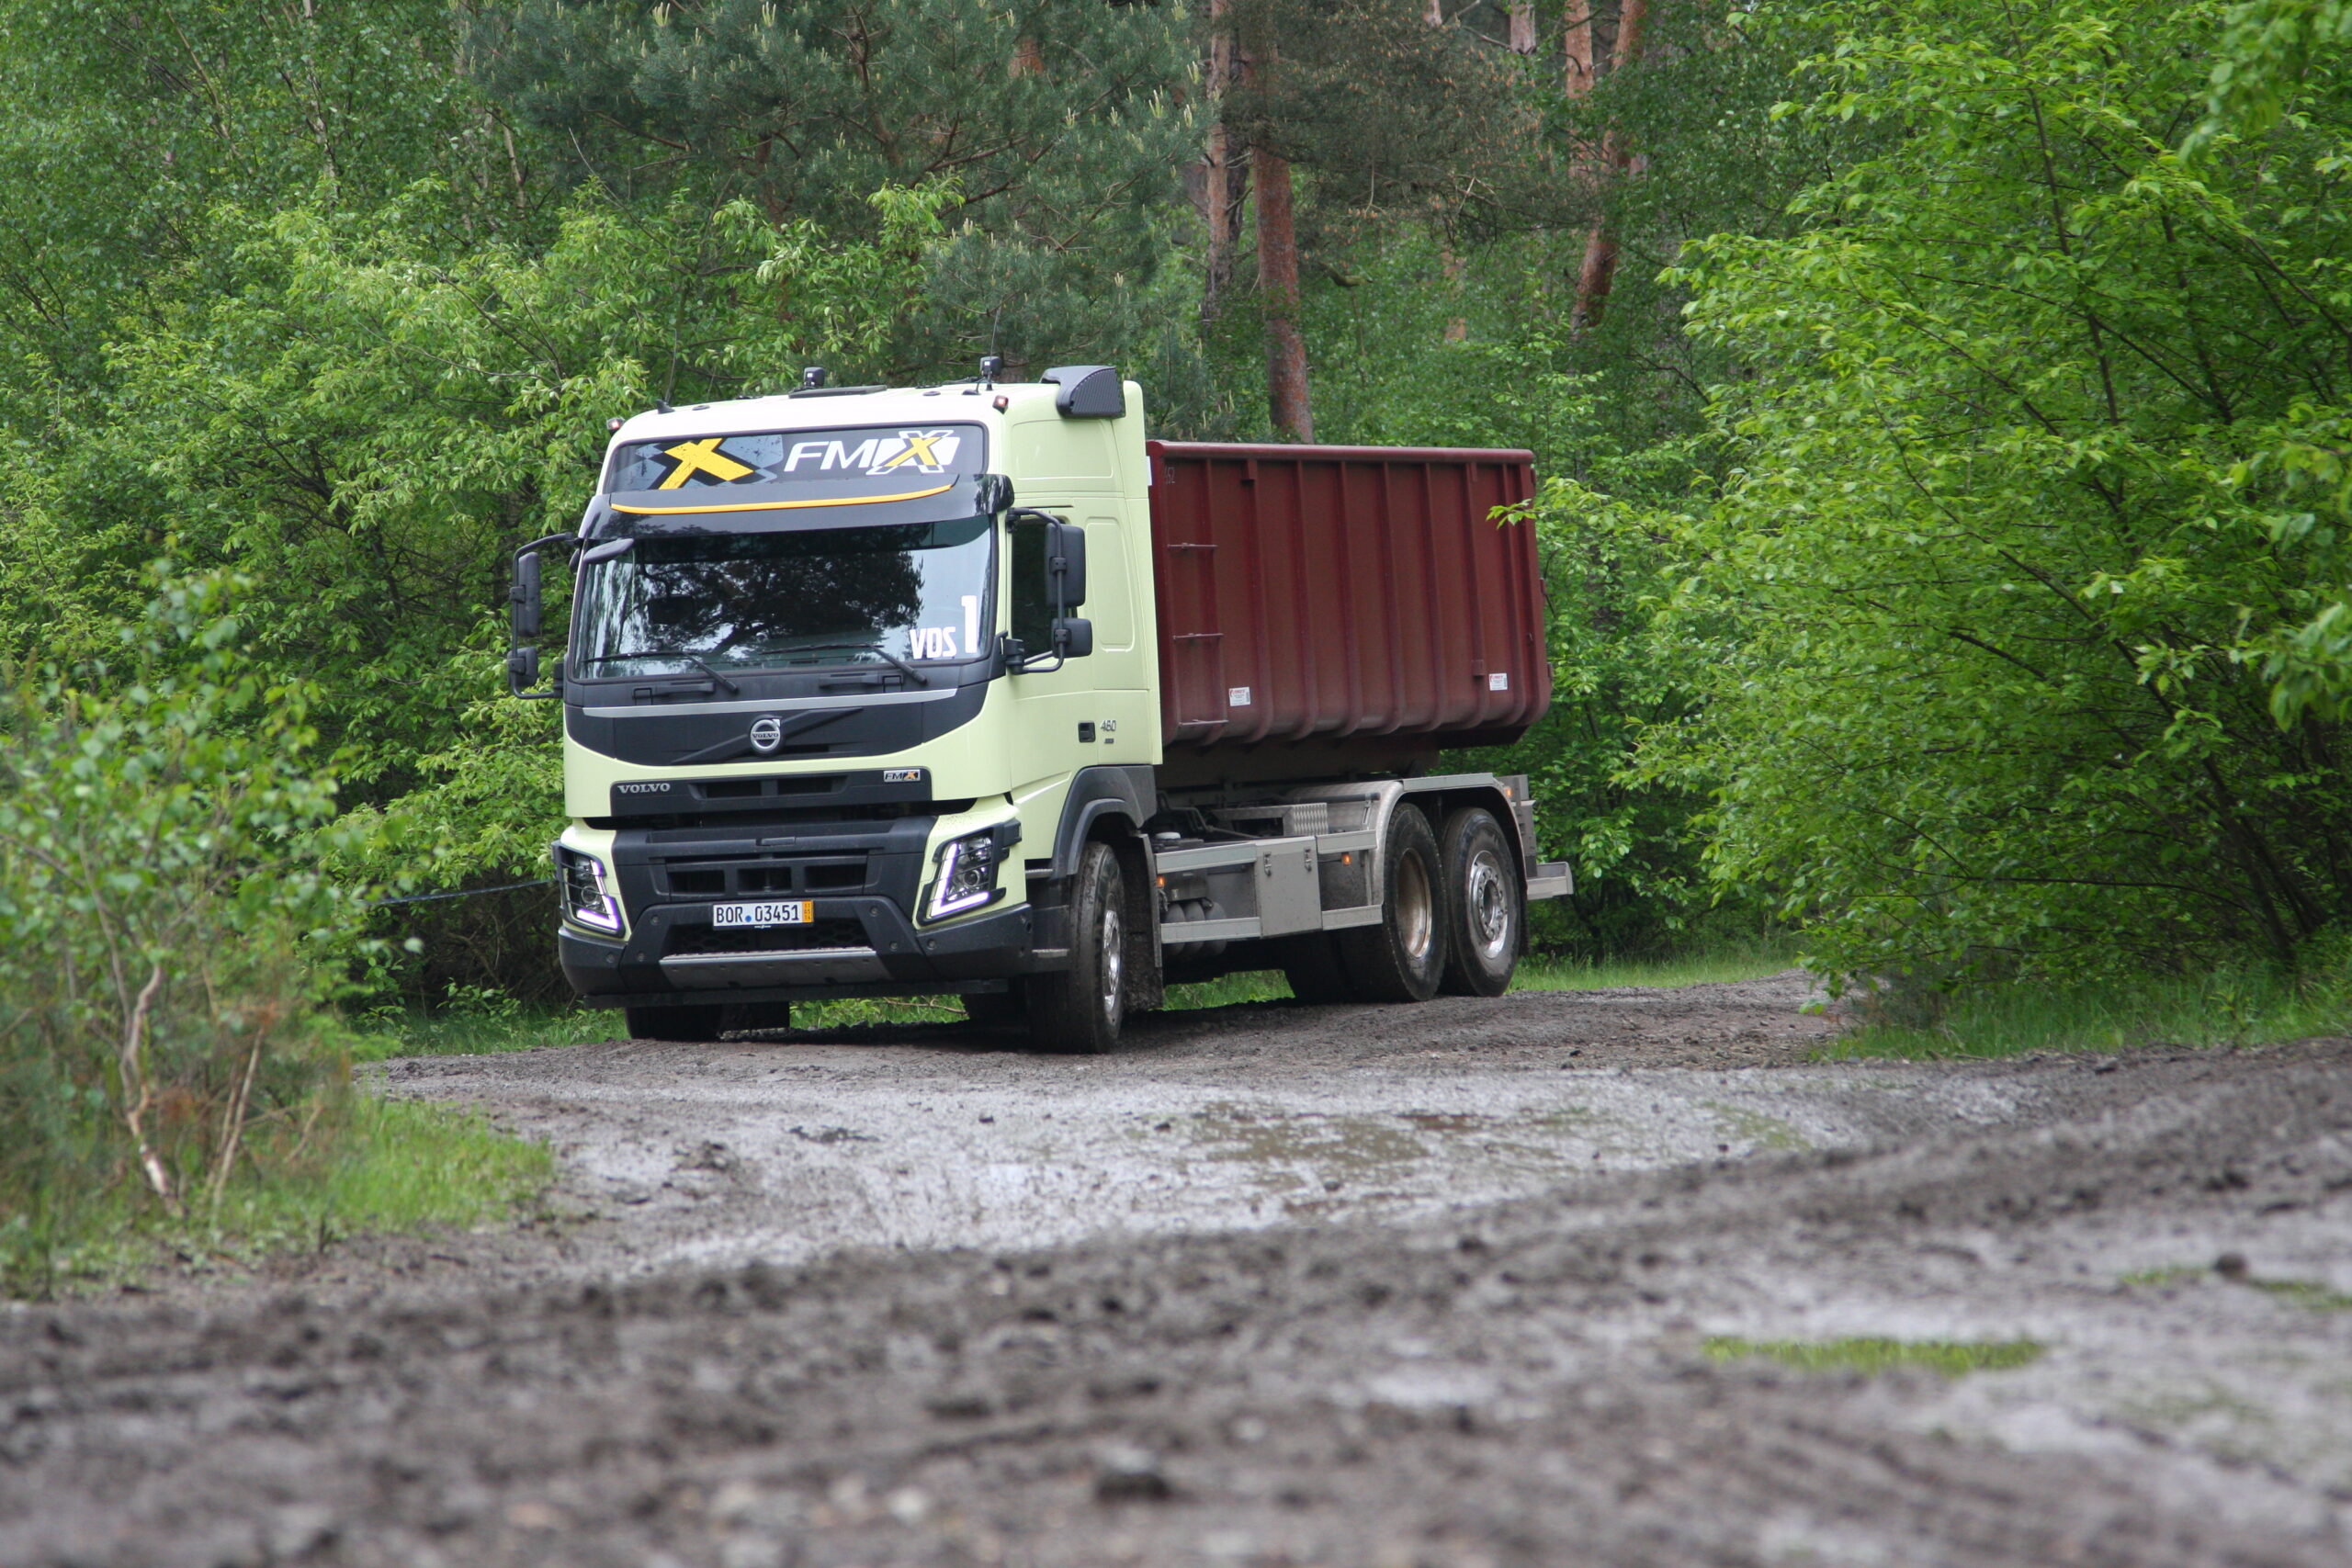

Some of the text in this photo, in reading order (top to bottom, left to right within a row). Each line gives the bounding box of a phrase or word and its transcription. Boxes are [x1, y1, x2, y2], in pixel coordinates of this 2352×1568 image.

[784, 430, 961, 475] FMX
[909, 595, 978, 660] VDS 1
[1100, 720, 1117, 732] 460
[617, 783, 671, 794] VOLVO
[717, 904, 799, 923] BOR 03451
